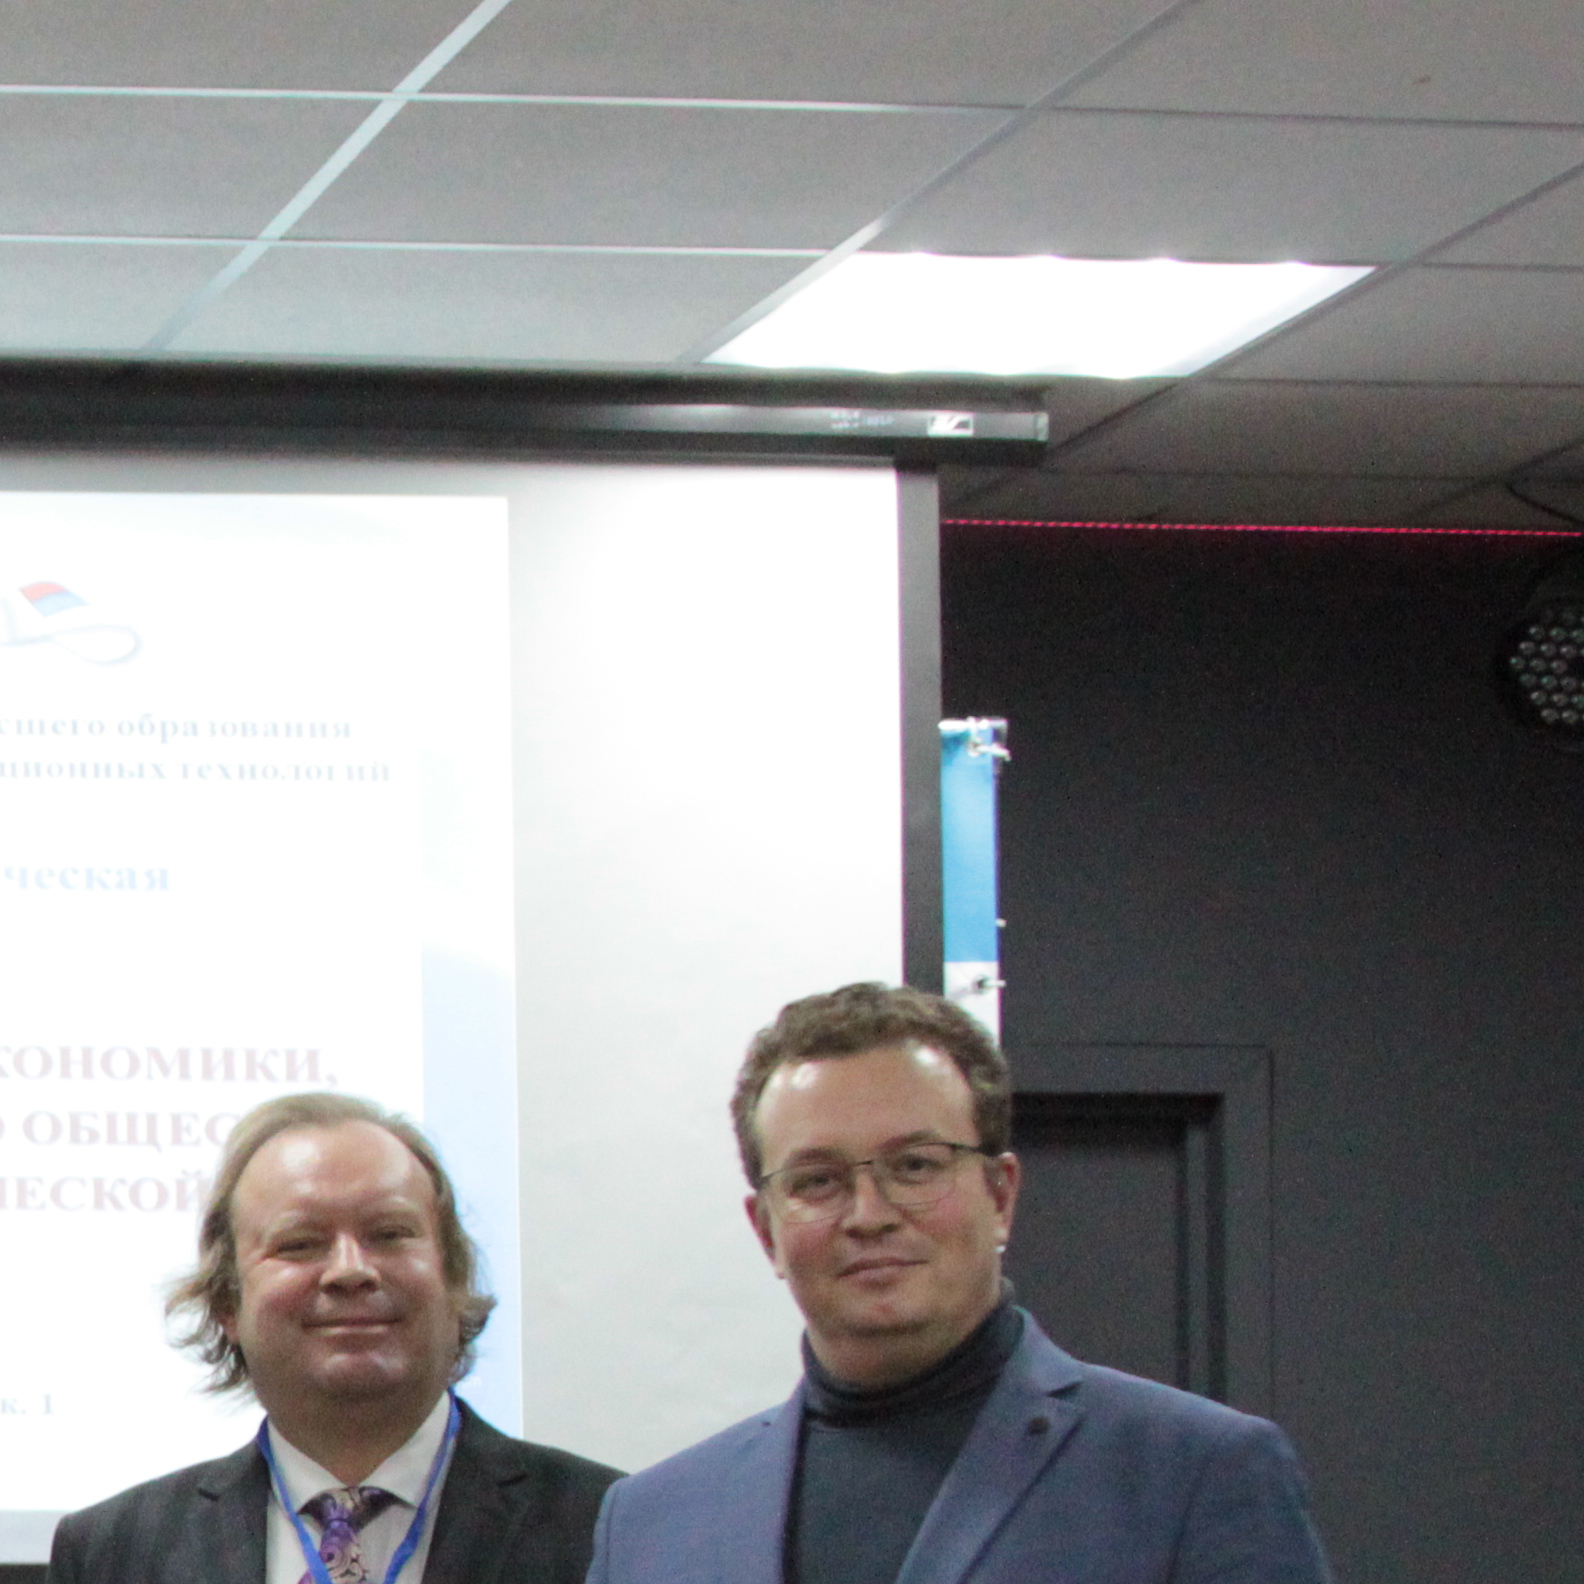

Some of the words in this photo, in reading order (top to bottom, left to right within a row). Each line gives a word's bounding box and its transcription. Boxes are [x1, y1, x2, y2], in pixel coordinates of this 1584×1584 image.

[116, 711, 353, 745] образования
[178, 757, 392, 783] технологий
[20, 1108, 241, 1154] ОБЩЕС
